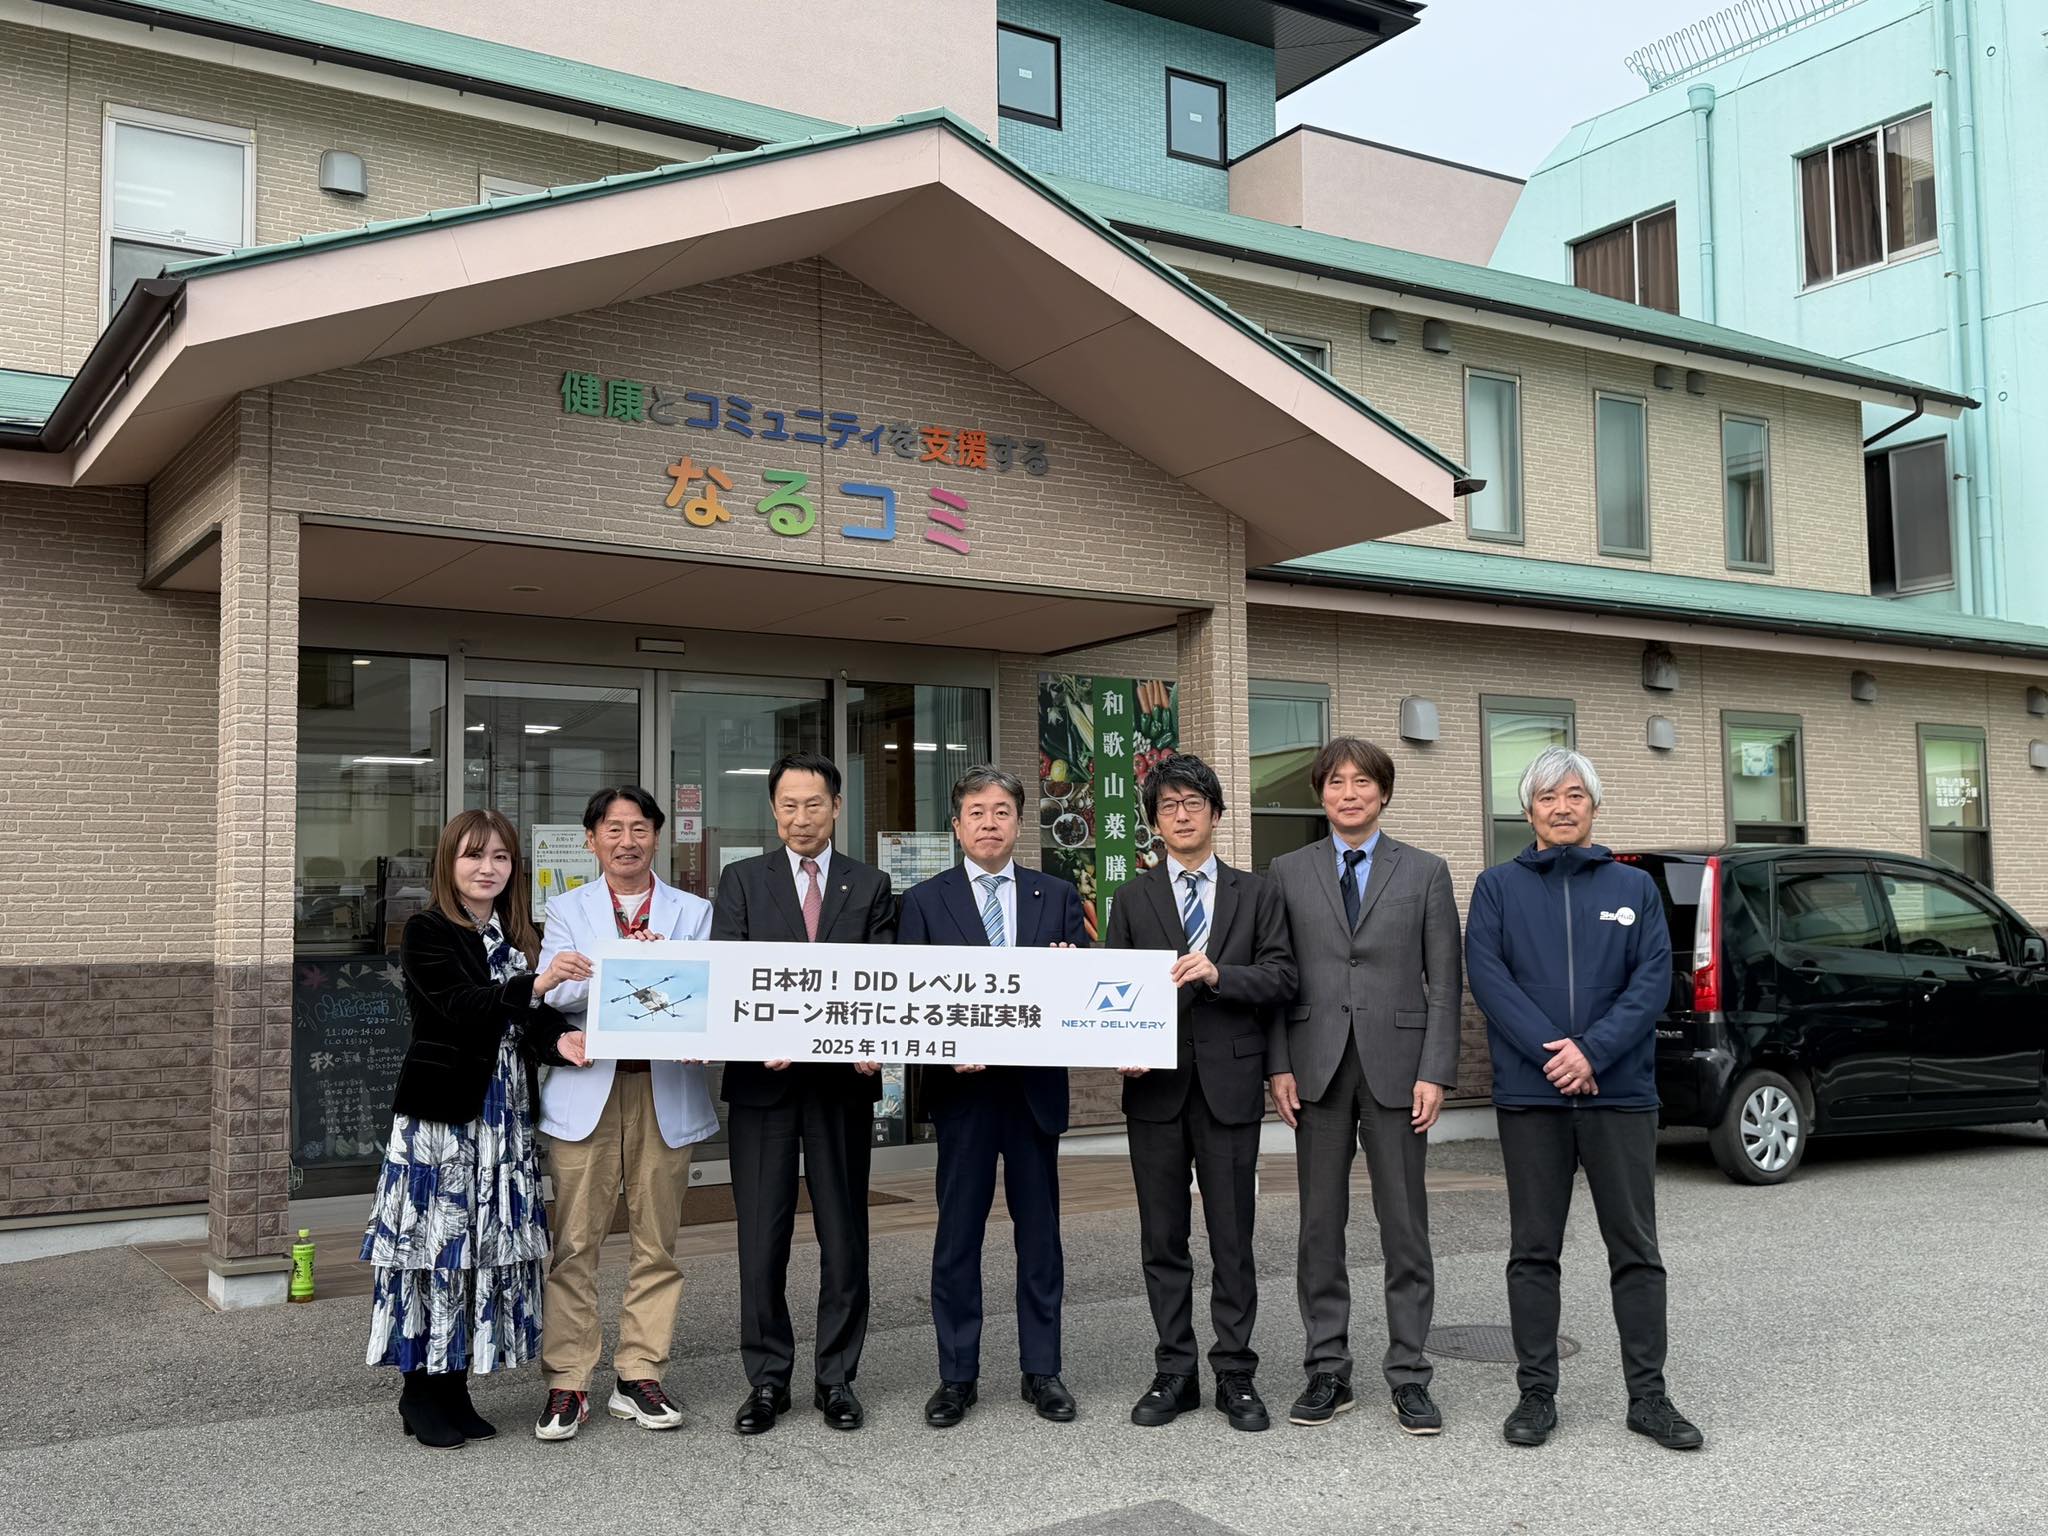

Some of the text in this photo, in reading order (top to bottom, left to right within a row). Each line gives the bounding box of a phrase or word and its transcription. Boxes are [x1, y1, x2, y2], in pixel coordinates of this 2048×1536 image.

[560, 369, 1050, 477] 健康とコミュニティを支援する
[665, 455, 970, 555] なるコミ
[731, 1000, 1042, 1030] ドローン飛行による実証実験
[1061, 1019, 1167, 1030] NEXT DELIVERY
